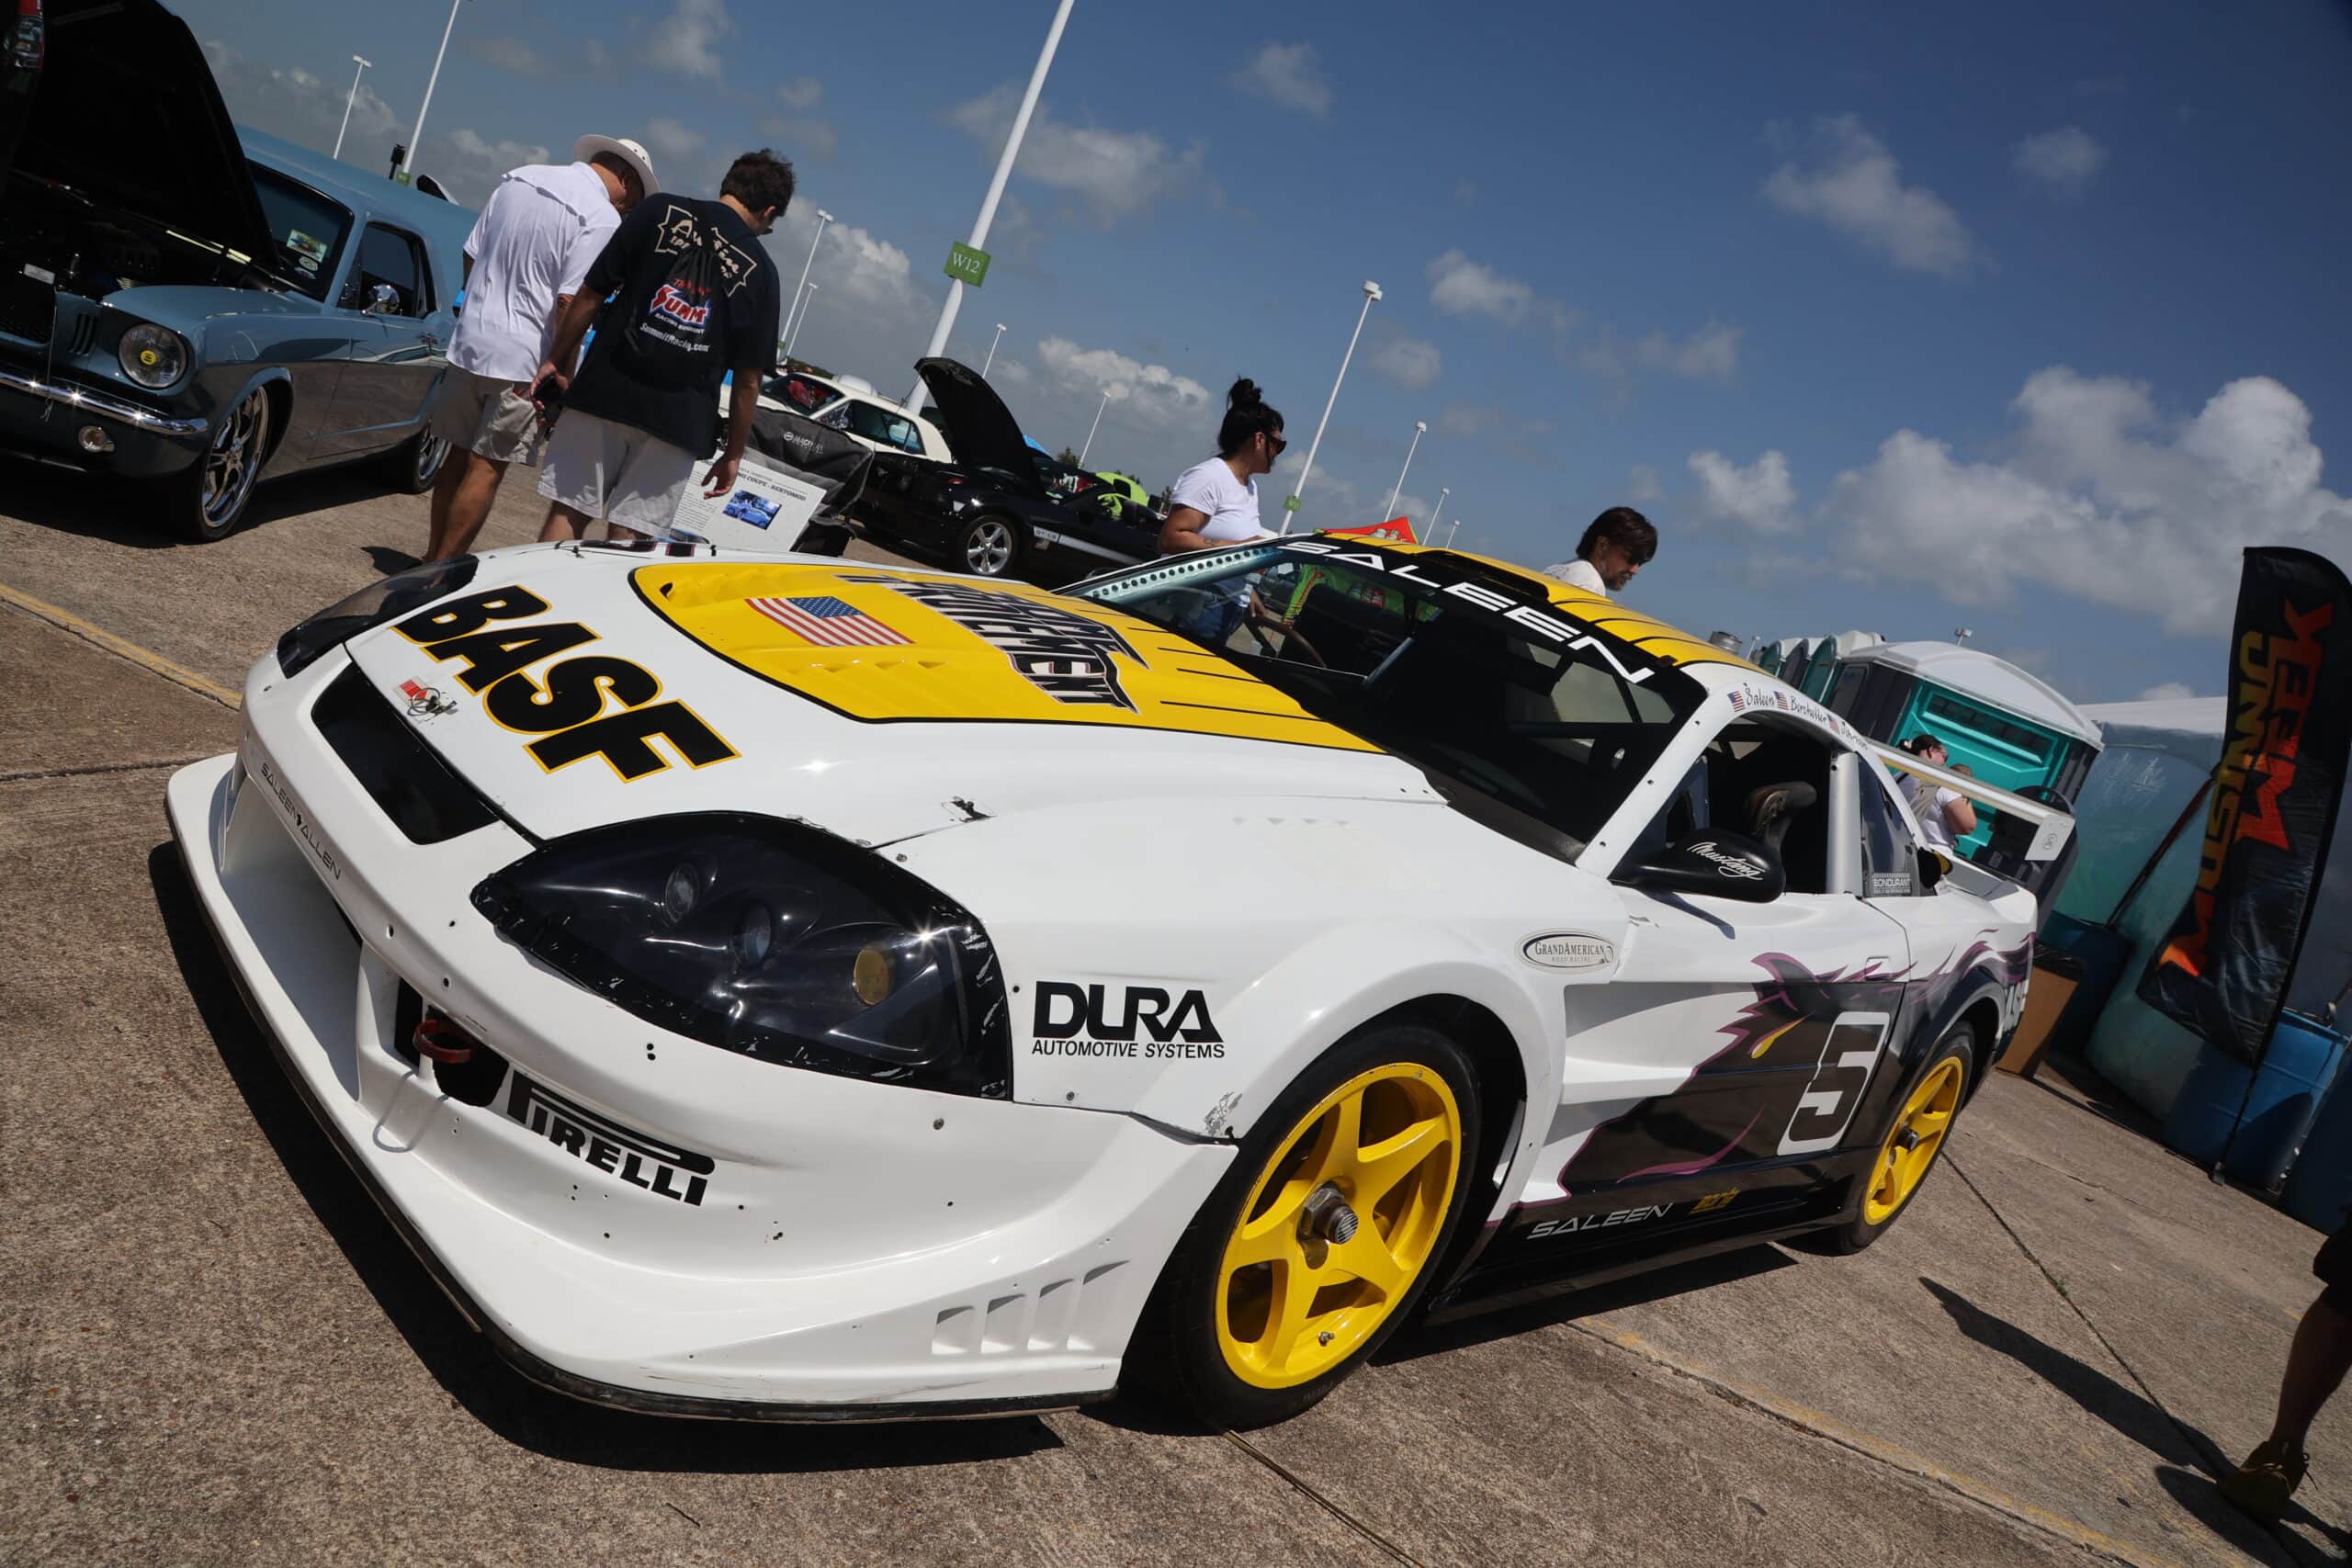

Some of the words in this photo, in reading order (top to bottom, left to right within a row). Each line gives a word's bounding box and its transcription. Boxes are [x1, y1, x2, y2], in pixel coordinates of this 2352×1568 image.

[953, 252, 980, 274] W12
[1276, 541, 1656, 685] SALEEN
[386, 584, 743, 784] BASF
[2234, 599, 2334, 851] WEEK
[261, 761, 299, 820] SALEEN
[300, 825, 342, 881] ALLEN
[1686, 842, 1767, 881] Mustang
[2158, 630, 2271, 977] MUSTANG
[1873, 877, 1911, 888] BONDURANT
[1032, 1039, 1139, 1058] AUTOMOTIVE
[1144, 1043, 1226, 1059] SYSTEMS
[1033, 980, 1224, 1043] DURA
[506, 1069, 716, 1207] PIRELLI
[1777, 1011, 1890, 1156] 5
[1526, 1202, 1675, 1240] SALEEN
